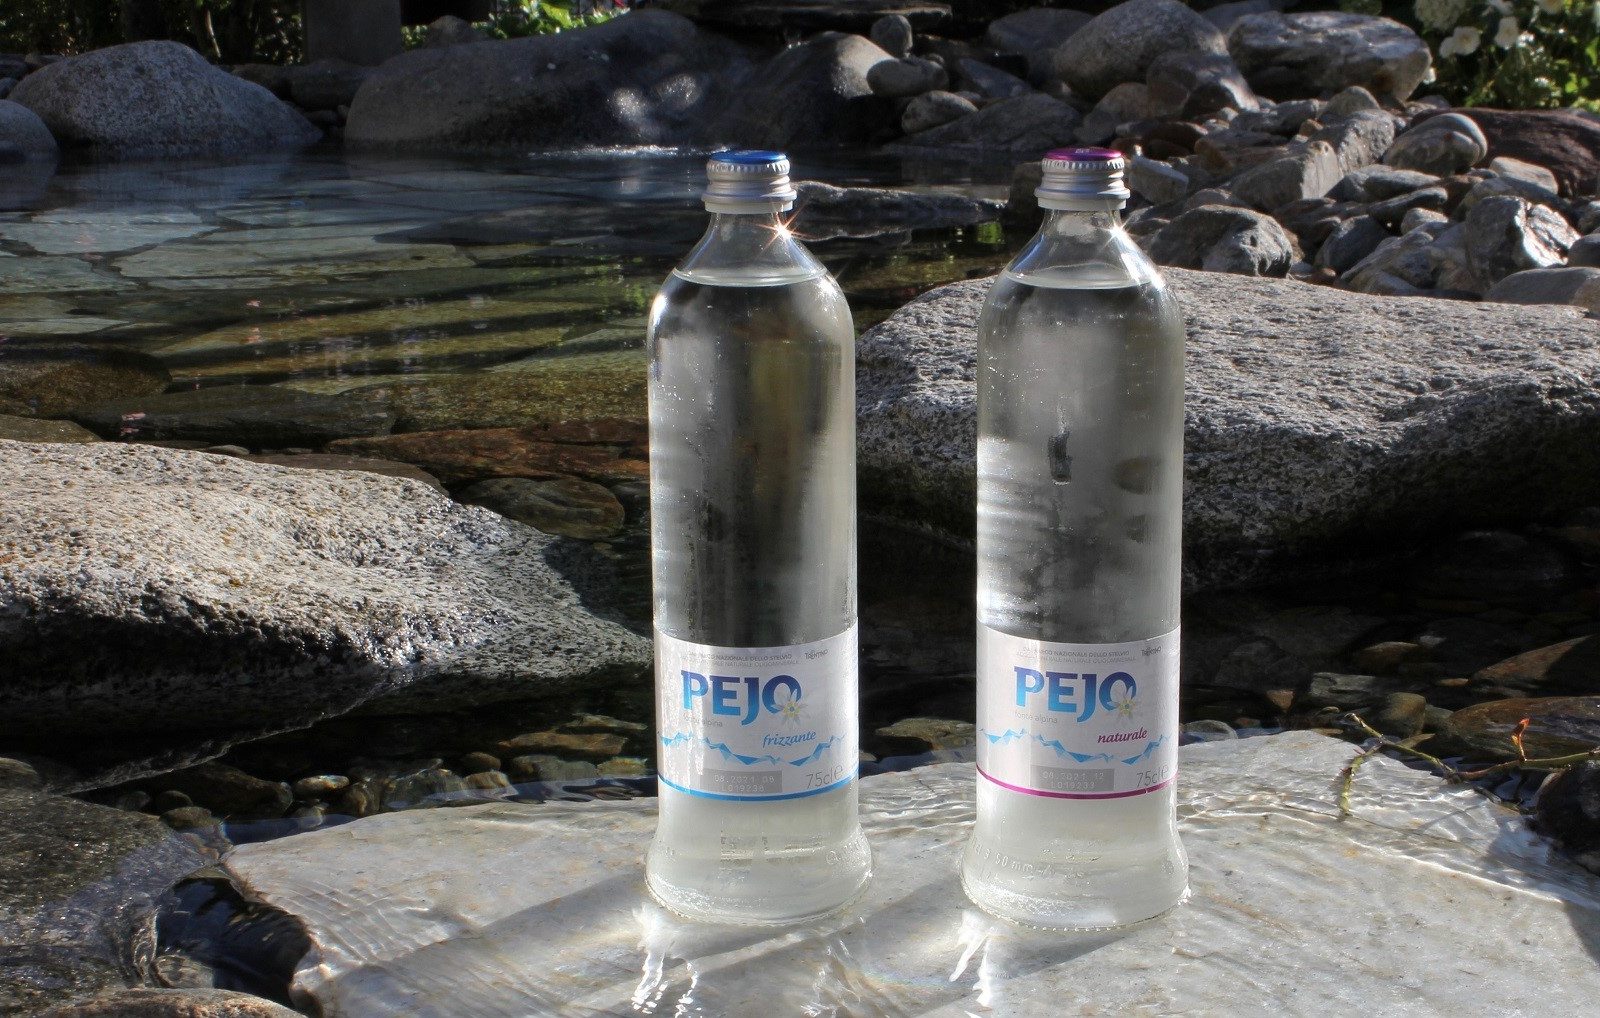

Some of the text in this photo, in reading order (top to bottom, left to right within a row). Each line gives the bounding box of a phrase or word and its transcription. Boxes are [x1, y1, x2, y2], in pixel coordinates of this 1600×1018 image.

[680, 669, 802, 726] PEJO
[1013, 665, 1137, 723] PEJO
[763, 729, 817, 748] frizzante
[1097, 726, 1148, 744] naturale
